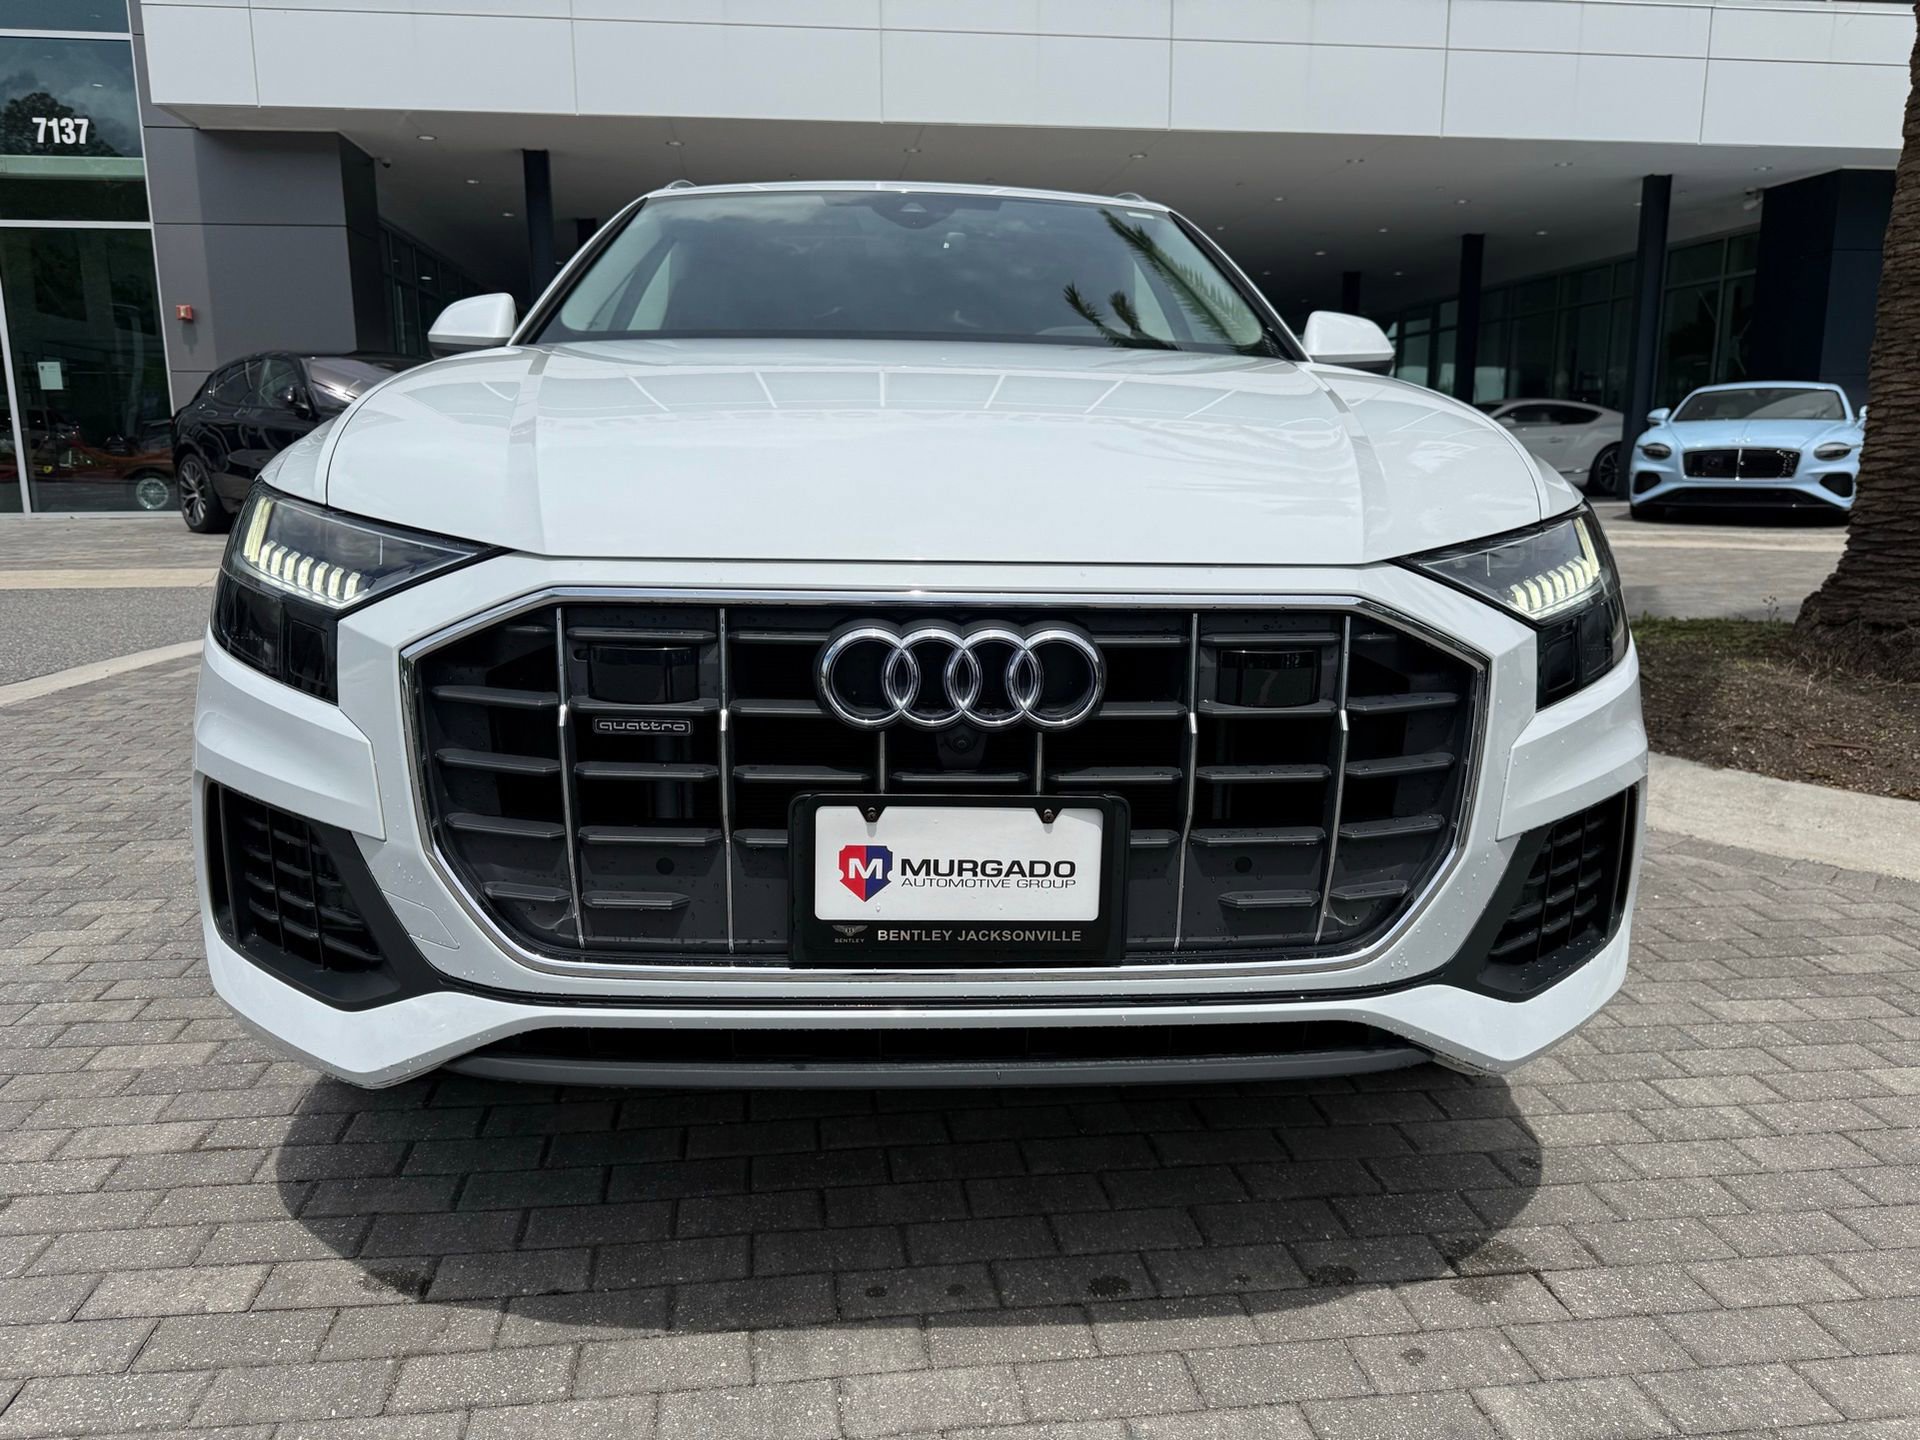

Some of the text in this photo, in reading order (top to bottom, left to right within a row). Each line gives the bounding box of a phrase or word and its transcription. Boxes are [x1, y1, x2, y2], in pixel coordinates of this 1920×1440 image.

[32, 117, 89, 145] 7137
[599, 721, 686, 731] quattro
[849, 858, 883, 880] M
[901, 859, 1076, 878] MURGADO
[901, 878, 1076, 889] AUTOMOTIVE GROUP
[877, 929, 1081, 941] BENTLEY JACKSONVILLE
